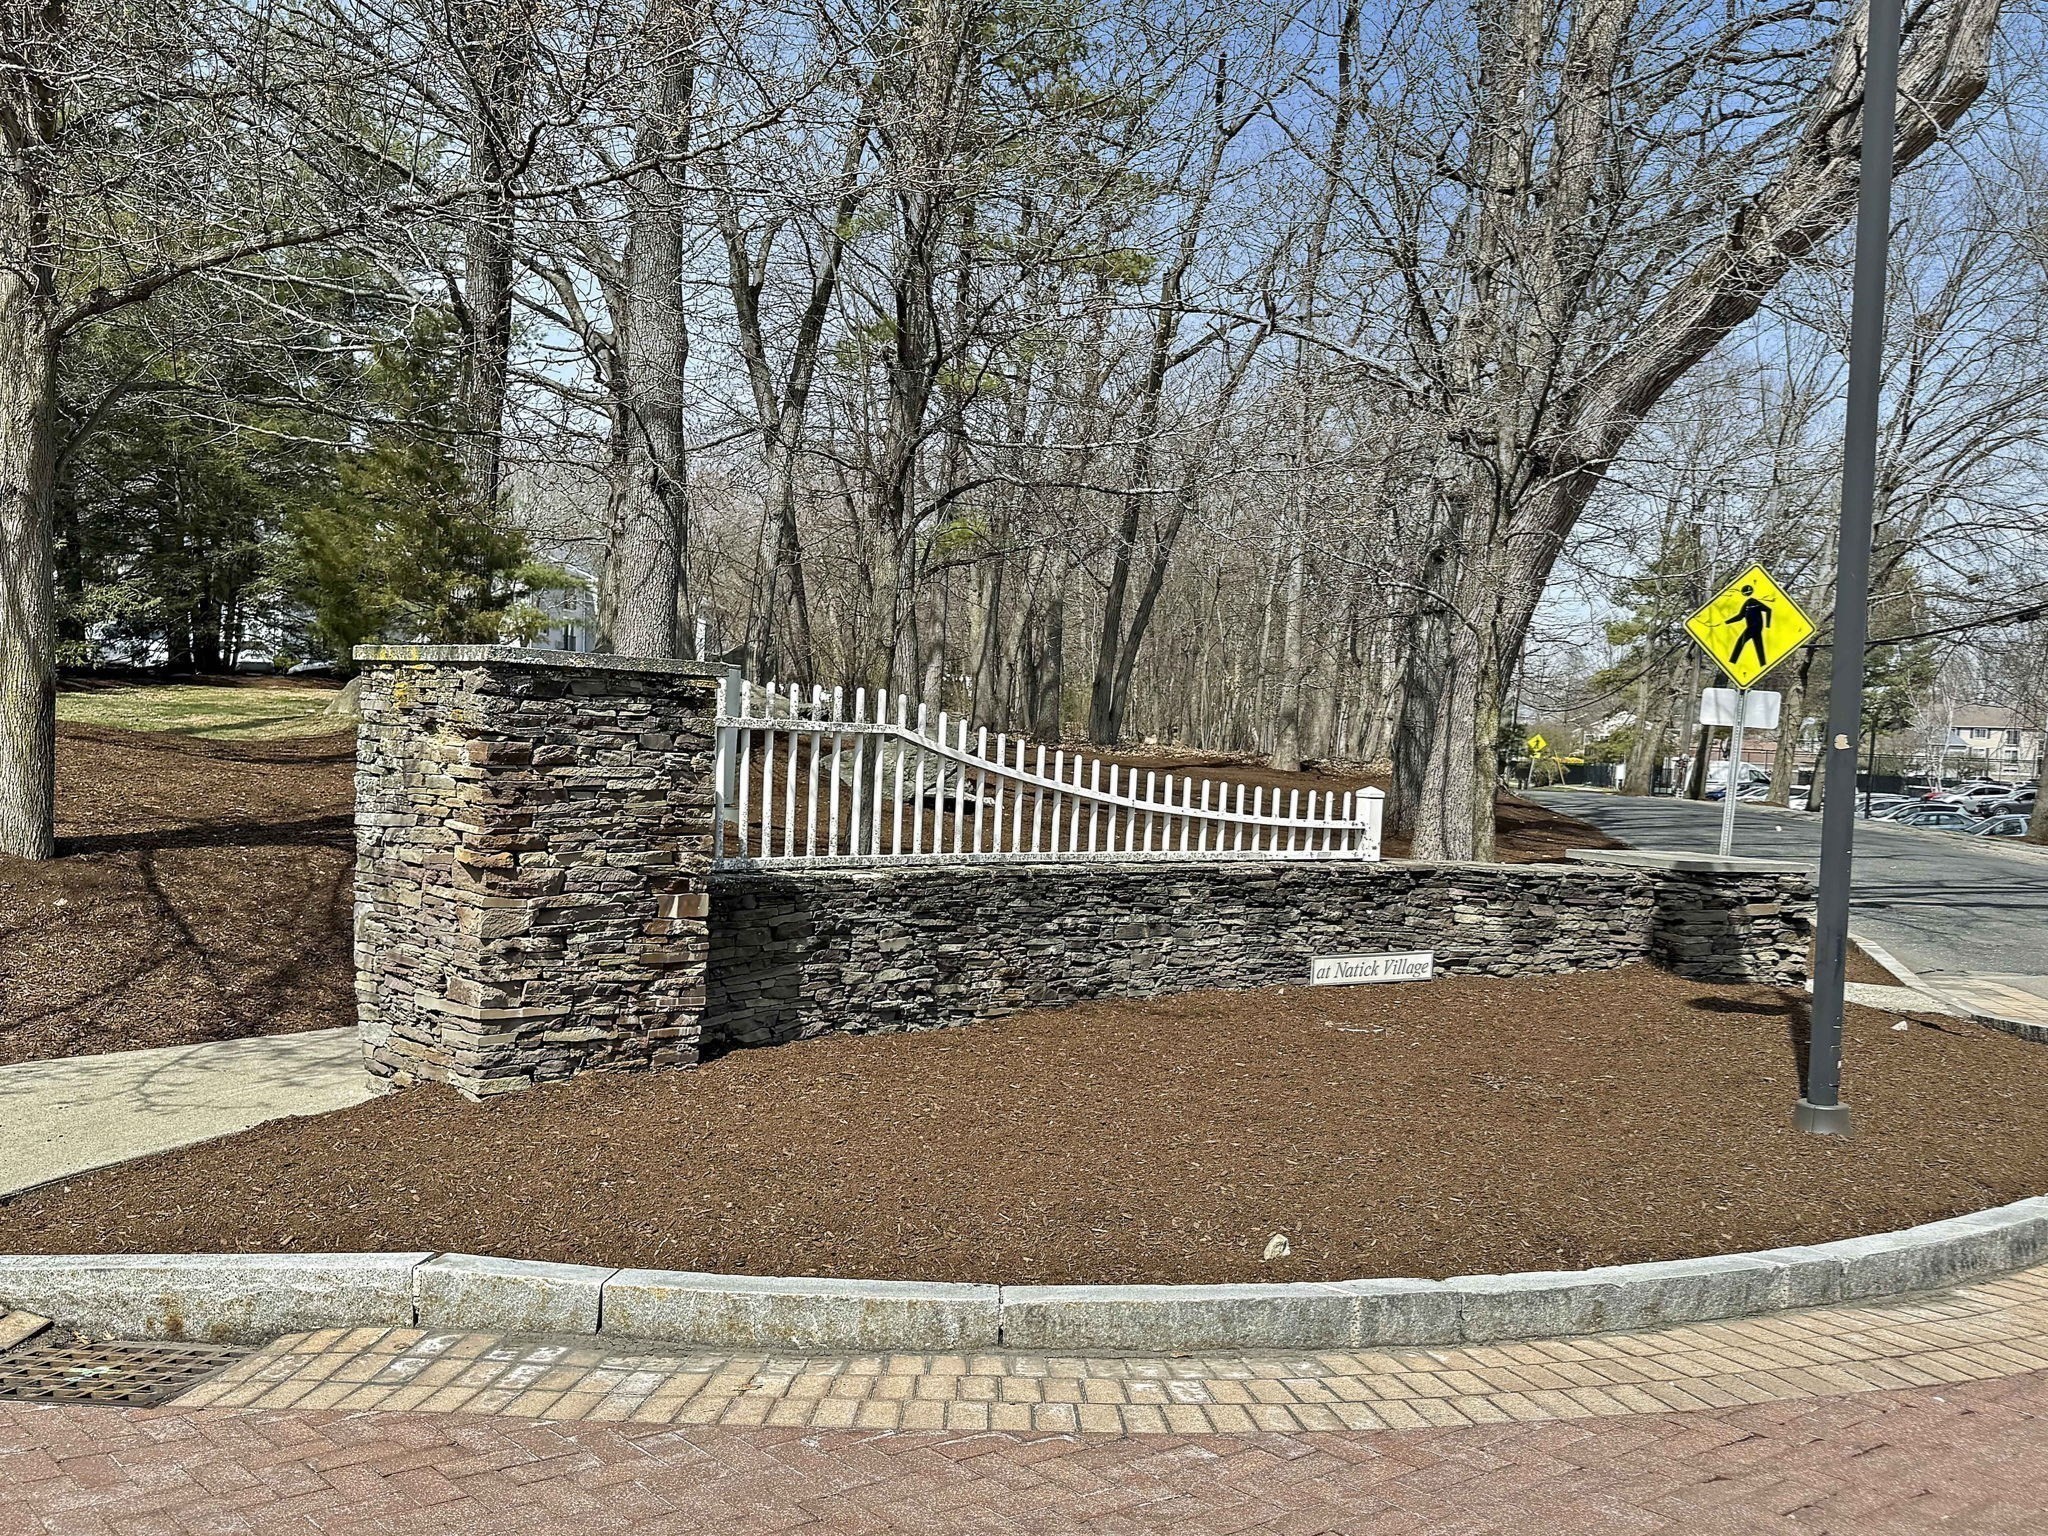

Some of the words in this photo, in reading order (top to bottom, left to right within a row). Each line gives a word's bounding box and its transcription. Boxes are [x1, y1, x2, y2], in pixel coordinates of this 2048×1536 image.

[1316, 965, 1331, 979] at
[1333, 960, 1380, 978] Natick
[1383, 958, 1429, 977] Village
